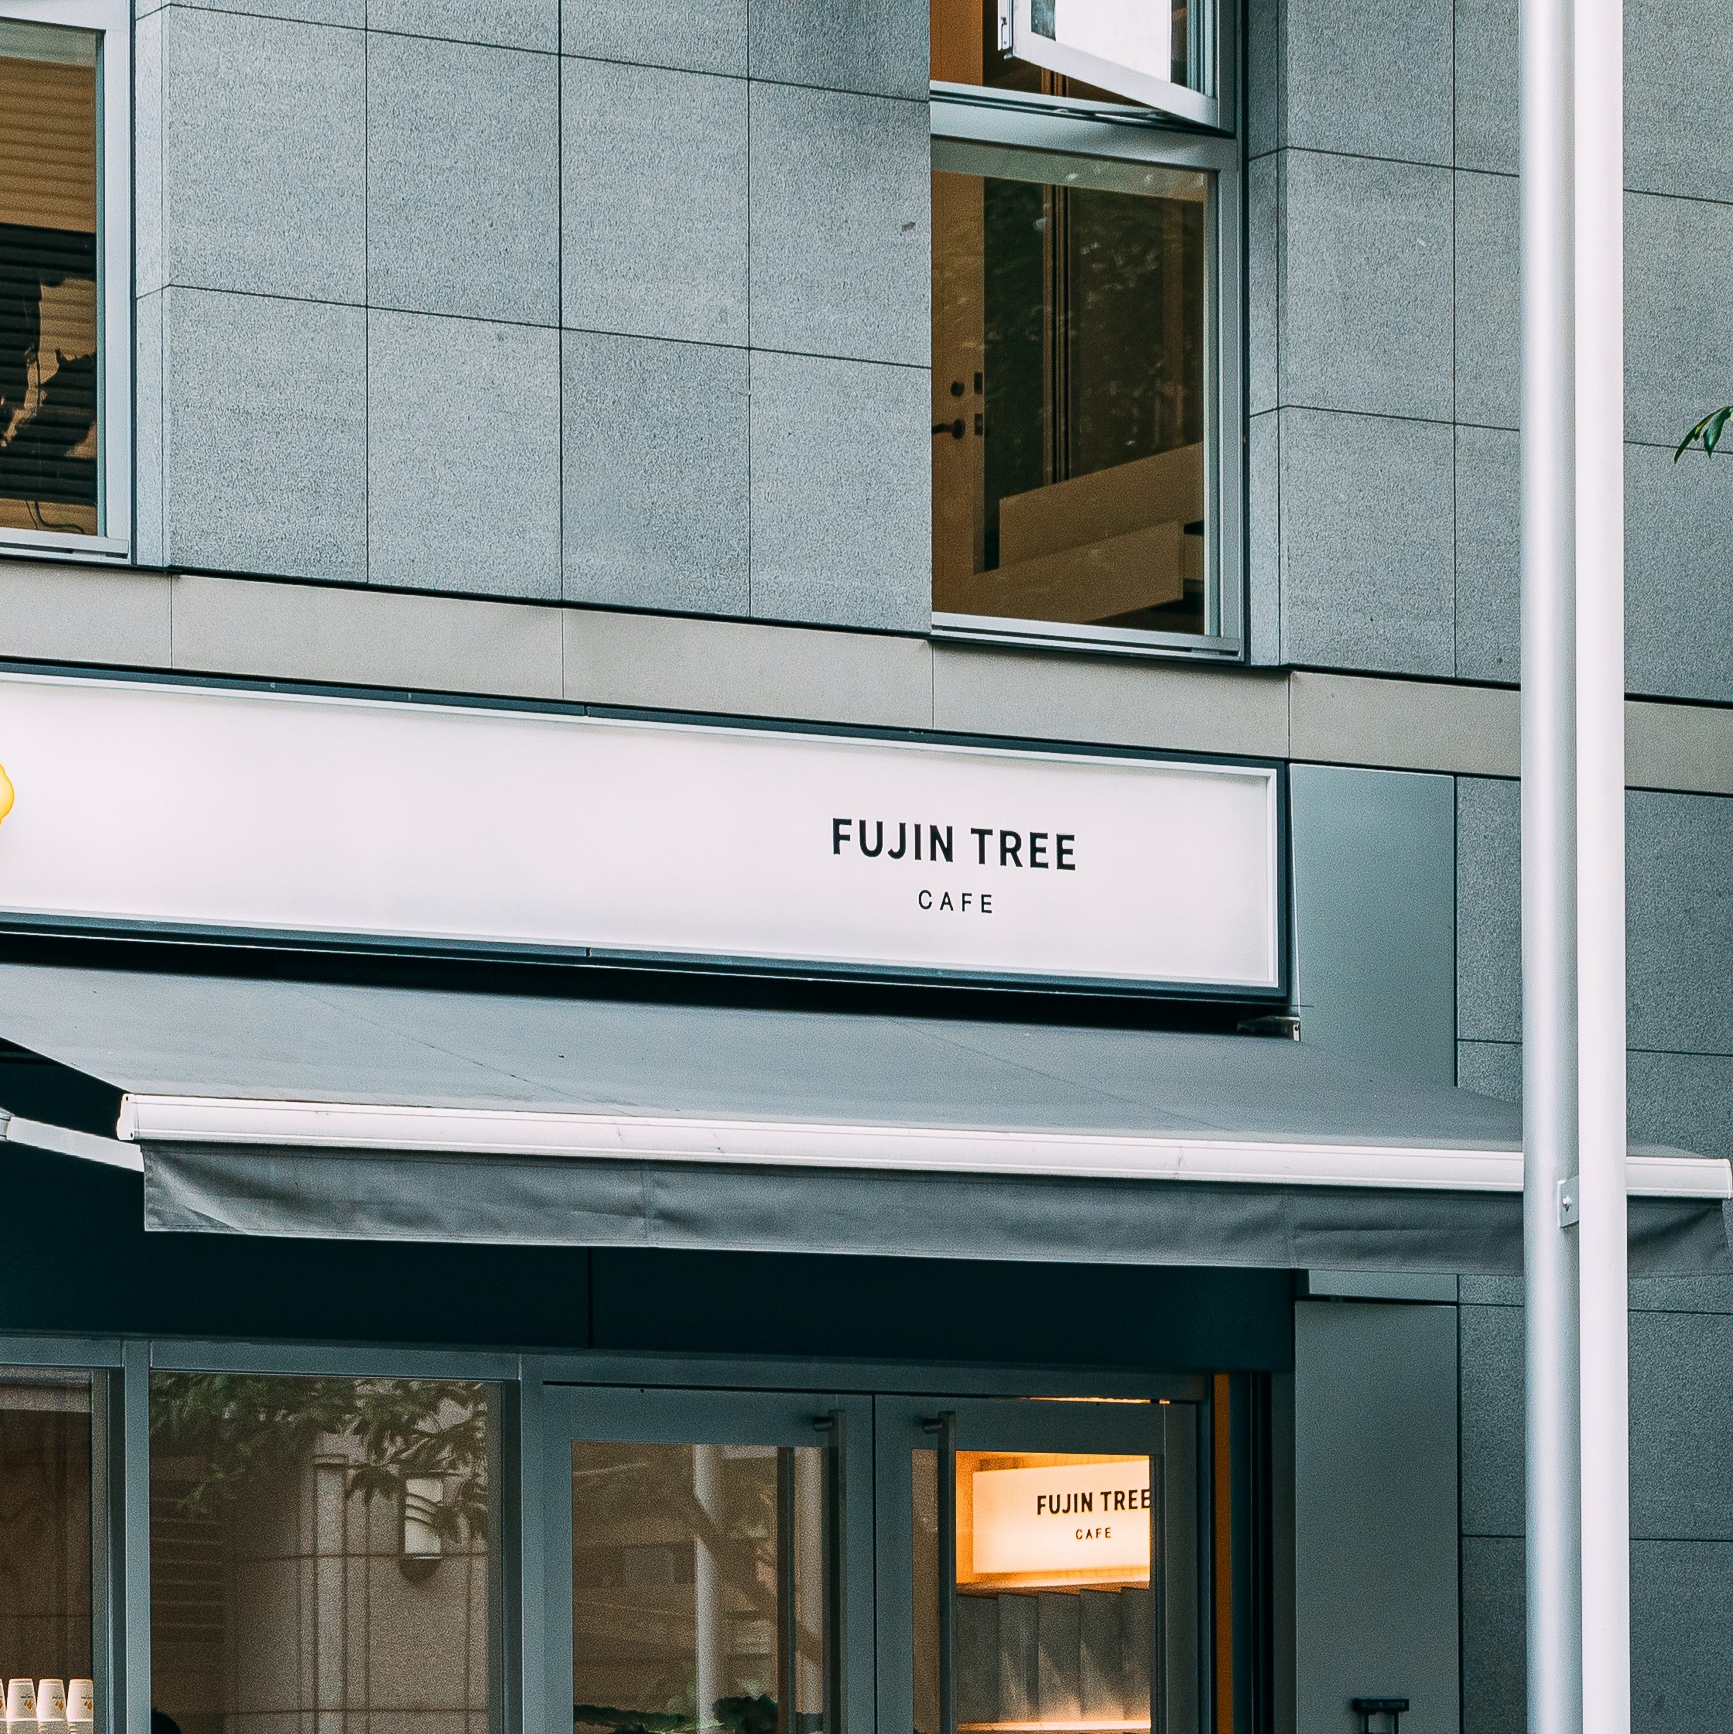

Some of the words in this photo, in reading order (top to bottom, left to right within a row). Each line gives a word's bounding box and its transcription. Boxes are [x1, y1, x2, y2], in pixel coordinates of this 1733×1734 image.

[832, 817, 954, 863] FUJIN
[970, 827, 1076, 871] TREE
[918, 889, 993, 914] CAFE
[1037, 1490, 1093, 1516] FUJIN
[1100, 1488, 1151, 1512] TREE
[1075, 1527, 1112, 1540] CAFE
